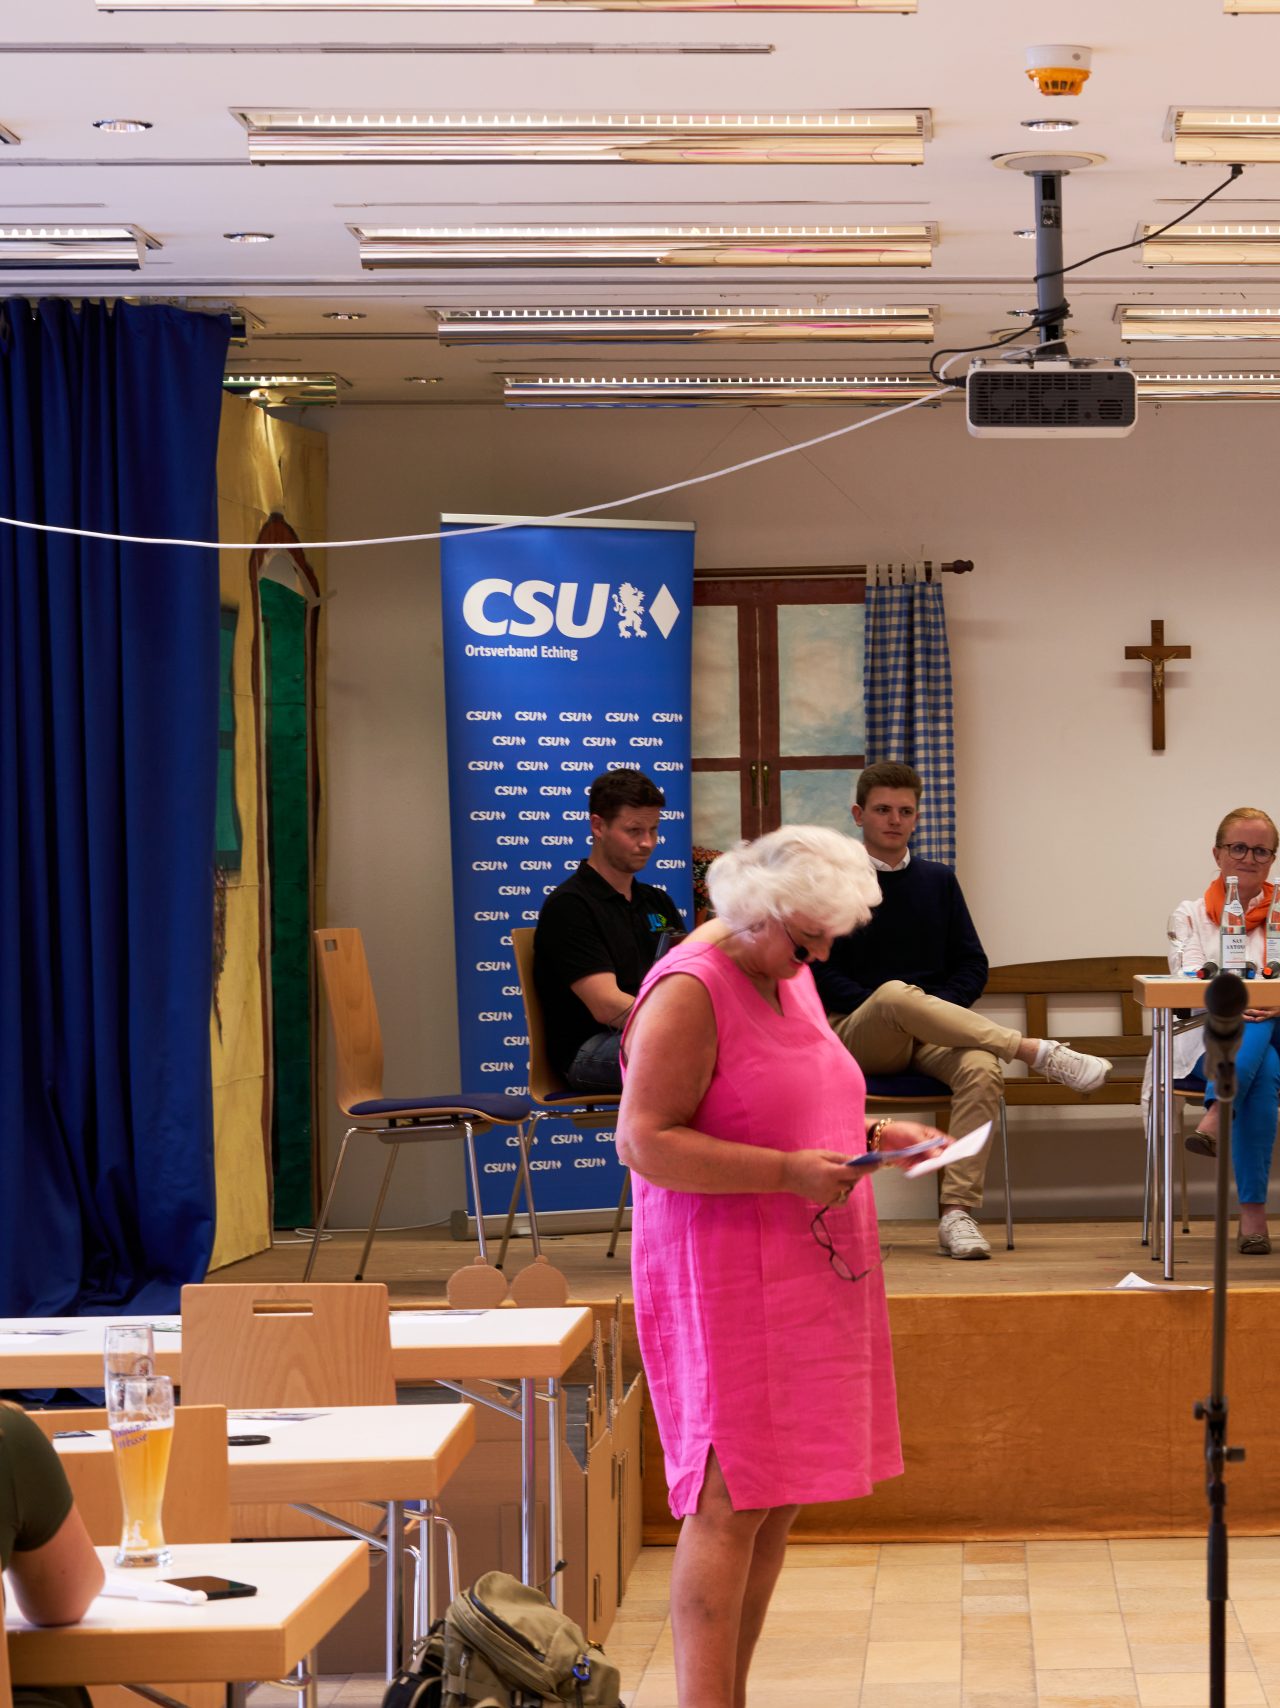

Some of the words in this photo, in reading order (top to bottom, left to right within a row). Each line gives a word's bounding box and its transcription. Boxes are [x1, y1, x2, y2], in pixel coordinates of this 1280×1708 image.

[462, 578, 611, 639] CSU
[465, 644, 538, 659] Ortsverband
[540, 645, 579, 662] Eching
[466, 710, 492, 721] CSU
[515, 710, 538, 722] CSU
[560, 711, 583, 722] CSU
[605, 712, 629, 723] CSU
[652, 712, 674, 723] CSU
[492, 735, 516, 746] CSU
[538, 735, 561, 747] CSU
[583, 736, 607, 747] CSU
[629, 736, 653, 747] CSU
[468, 760, 494, 771] CSU
[517, 760, 539, 771] CSU
[561, 761, 585, 772] CSU
[654, 761, 675, 772] CSU
[495, 785, 518, 796] CSU
[540, 785, 562, 797] CSU
[470, 810, 496, 821] CSU
[519, 810, 541, 821] CSU
[562, 810, 585, 821] CSU
[497, 835, 520, 846] CSU
[541, 835, 564, 846] CSU
[472, 860, 497, 871] CSU
[520, 860, 543, 871] CSU
[563, 860, 580, 870] CS
[656, 859, 677, 870] CSU
[498, 885, 521, 896] CSU
[542, 885, 557, 895] CS
[474, 911, 499, 922] CSU
[499, 935, 514, 946] CS
[476, 961, 501, 972] CSU
[479, 1011, 503, 1022] CSU
[503, 1035, 526, 1046] CSU
[480, 1061, 504, 1073] CSU
[504, 1086, 526, 1097] CSU
[506, 1136, 520, 1147] CS
[551, 1134, 574, 1145] CSU
[484, 1162, 507, 1174] CSU
[529, 1159, 552, 1171] CSU
[574, 1157, 597, 1169] CSU
